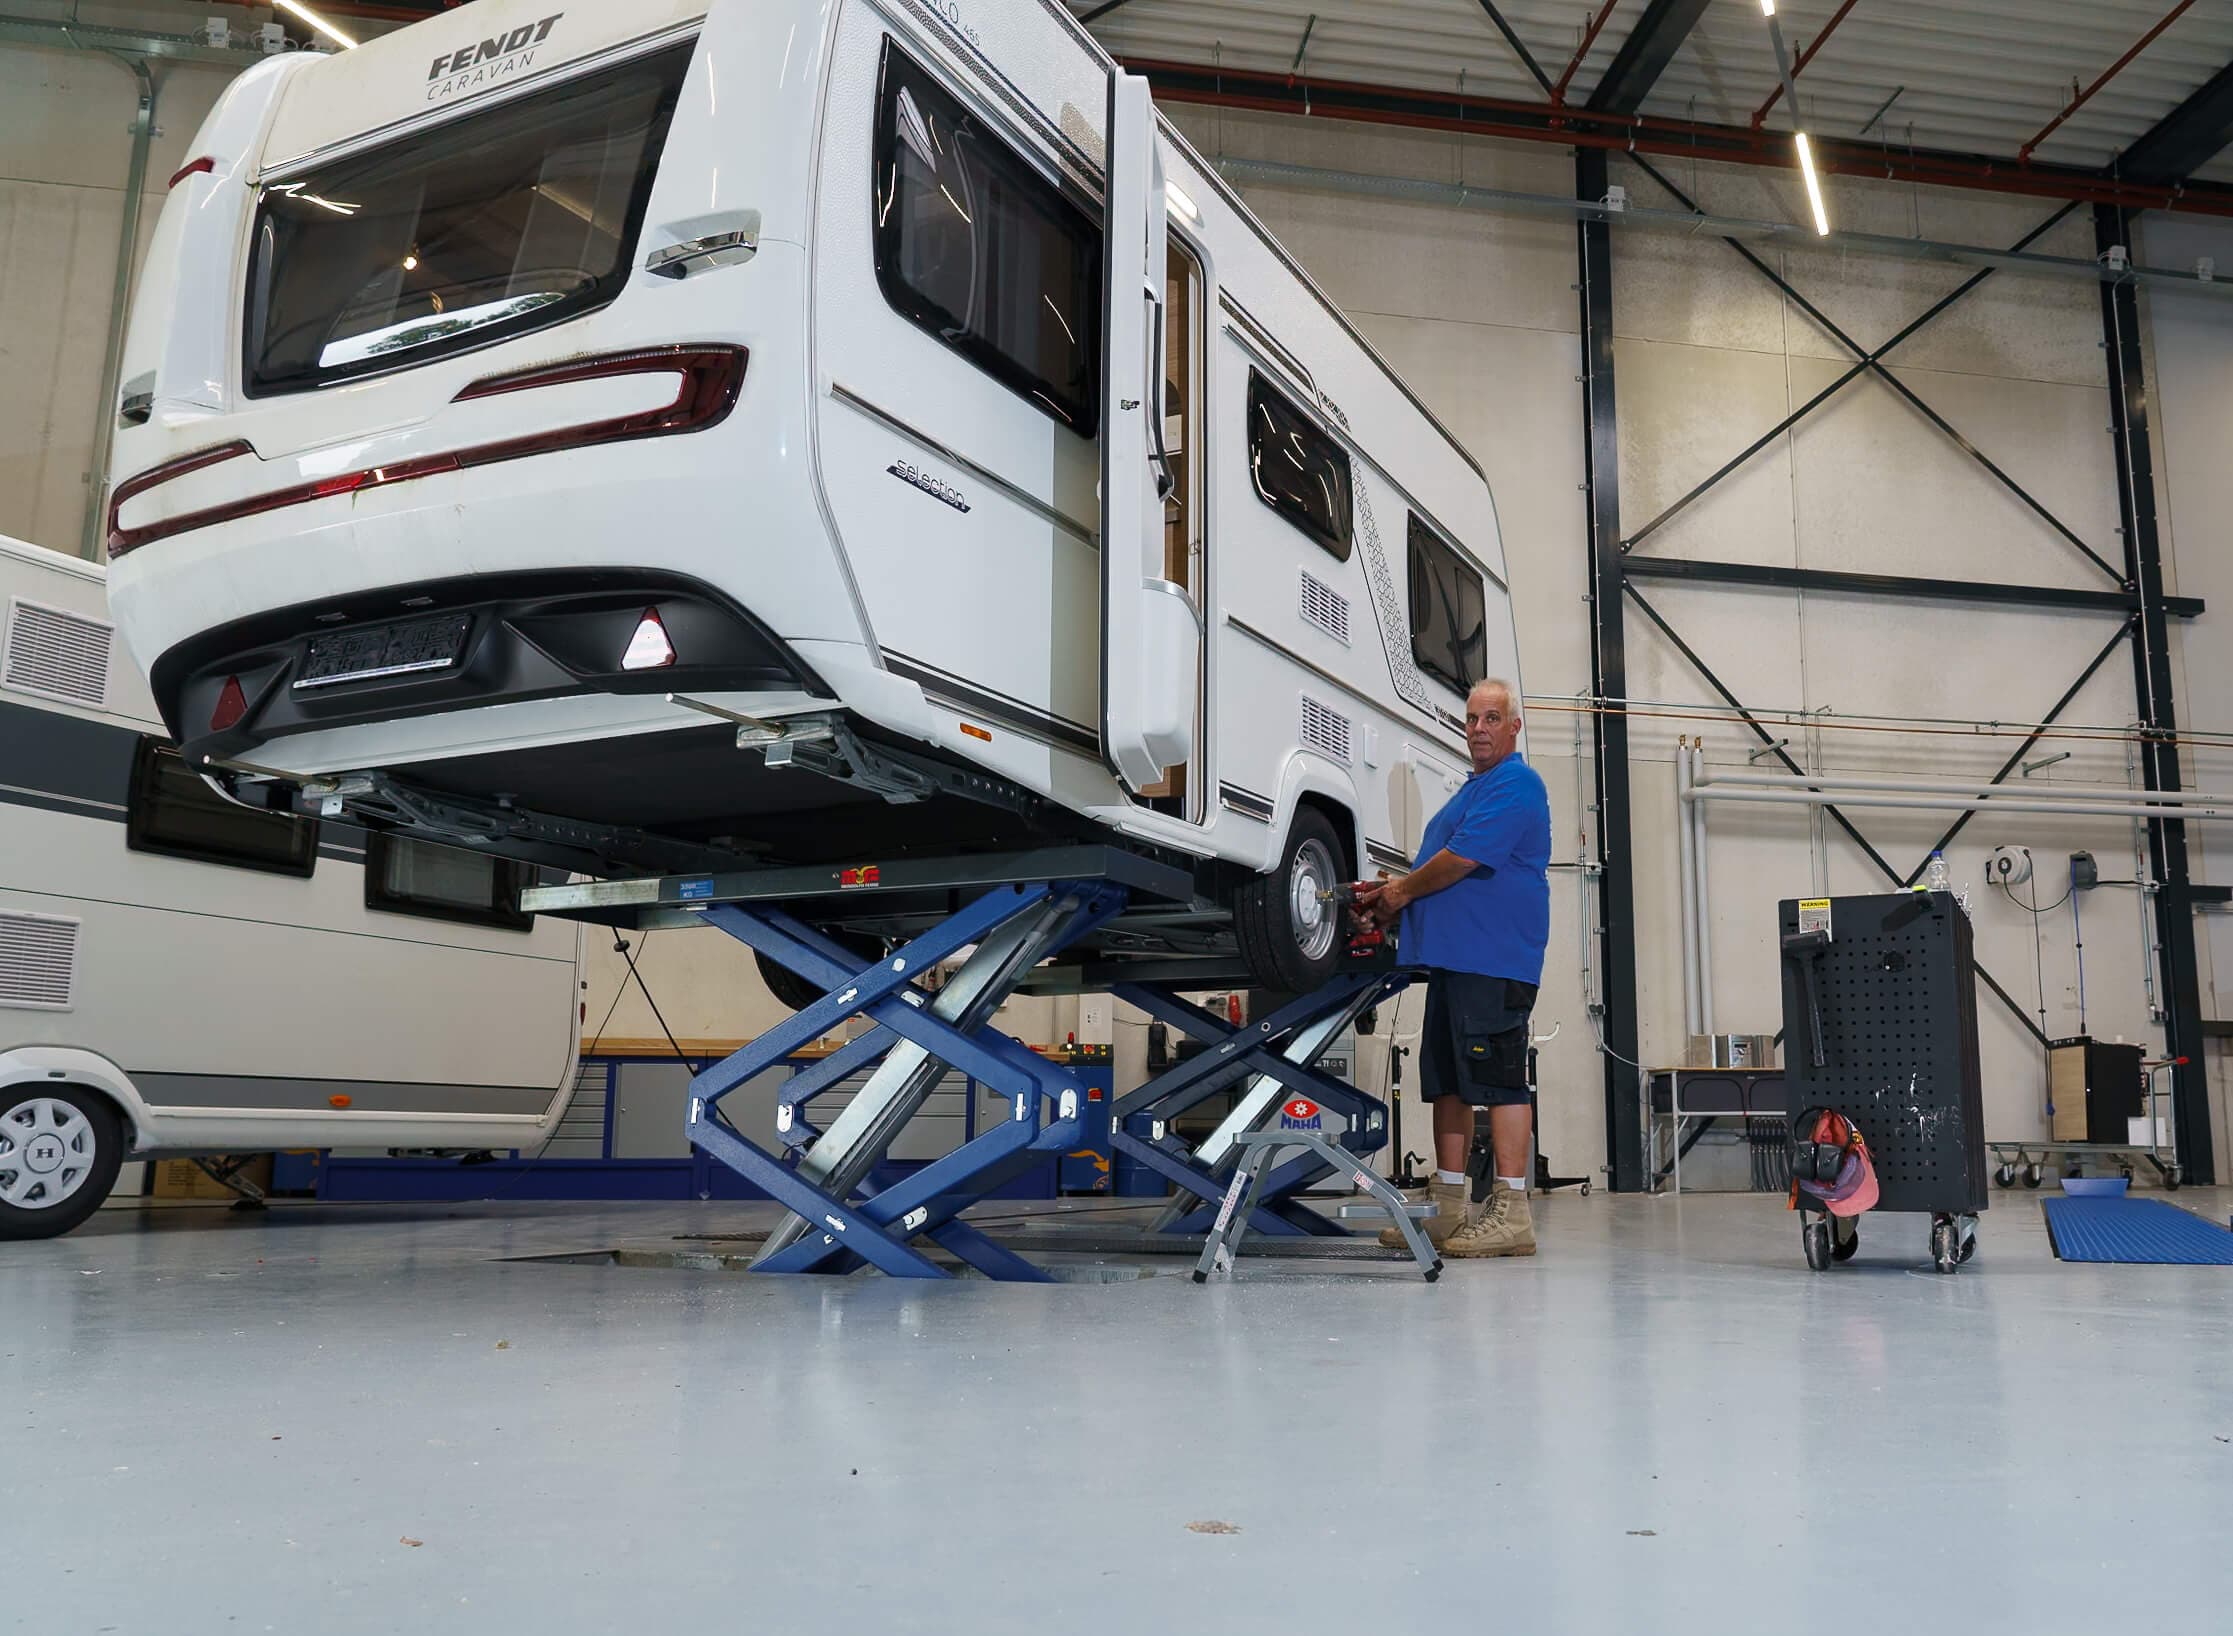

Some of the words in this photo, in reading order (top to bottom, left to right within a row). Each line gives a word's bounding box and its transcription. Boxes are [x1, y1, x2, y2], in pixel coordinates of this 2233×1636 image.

[428, 12, 565, 81] FENDT
[427, 51, 535, 100] CARAVAN
[895, 459, 966, 510] selection
[1280, 1113, 1322, 1129] MAHA
[36, 1148, 54, 1159] H
